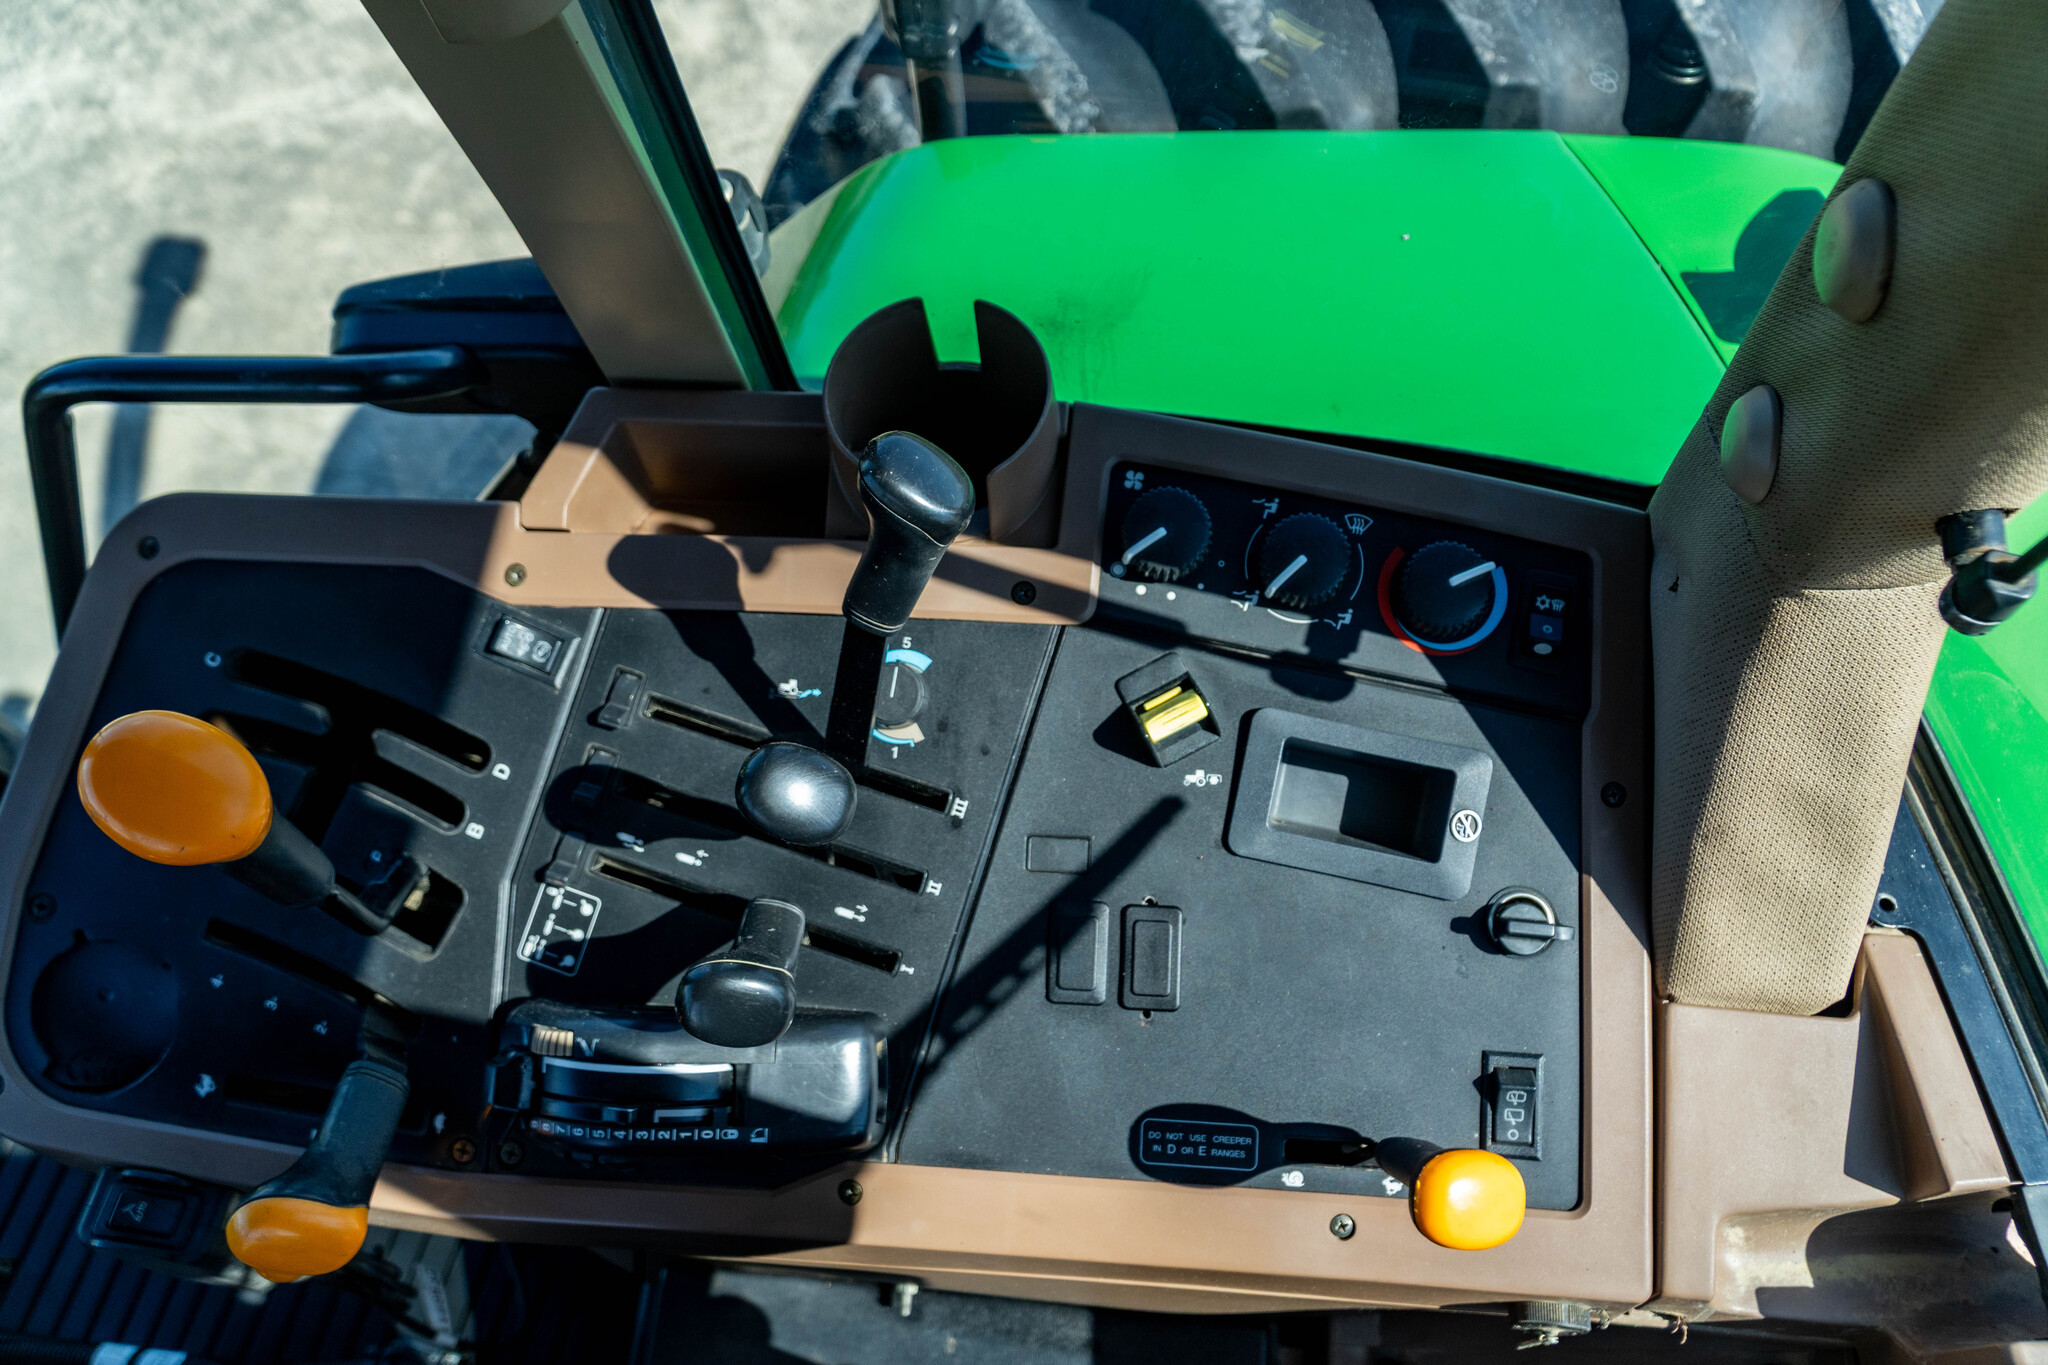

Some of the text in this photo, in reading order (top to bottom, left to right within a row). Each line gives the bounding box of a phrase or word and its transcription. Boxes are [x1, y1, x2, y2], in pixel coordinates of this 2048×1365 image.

[902, 636, 912, 649] 5
[891, 746, 899, 759] 1
[491, 762, 511, 780] D
[950, 797, 969, 819] III
[464, 822, 485, 840] B
[926, 879, 943, 896] II
[572, 1127, 585, 1137] 6
[593, 1129, 606, 1139] 5
[613, 1129, 627, 1139] 4
[635, 1129, 649, 1140] 3
[657, 1129, 671, 1140] 2
[678, 1131, 693, 1139] 1
[1148, 1131, 1252, 1145] DO NOT USE CREEPER
[1152, 1143, 1245, 1158] IN D OR E RANGES
